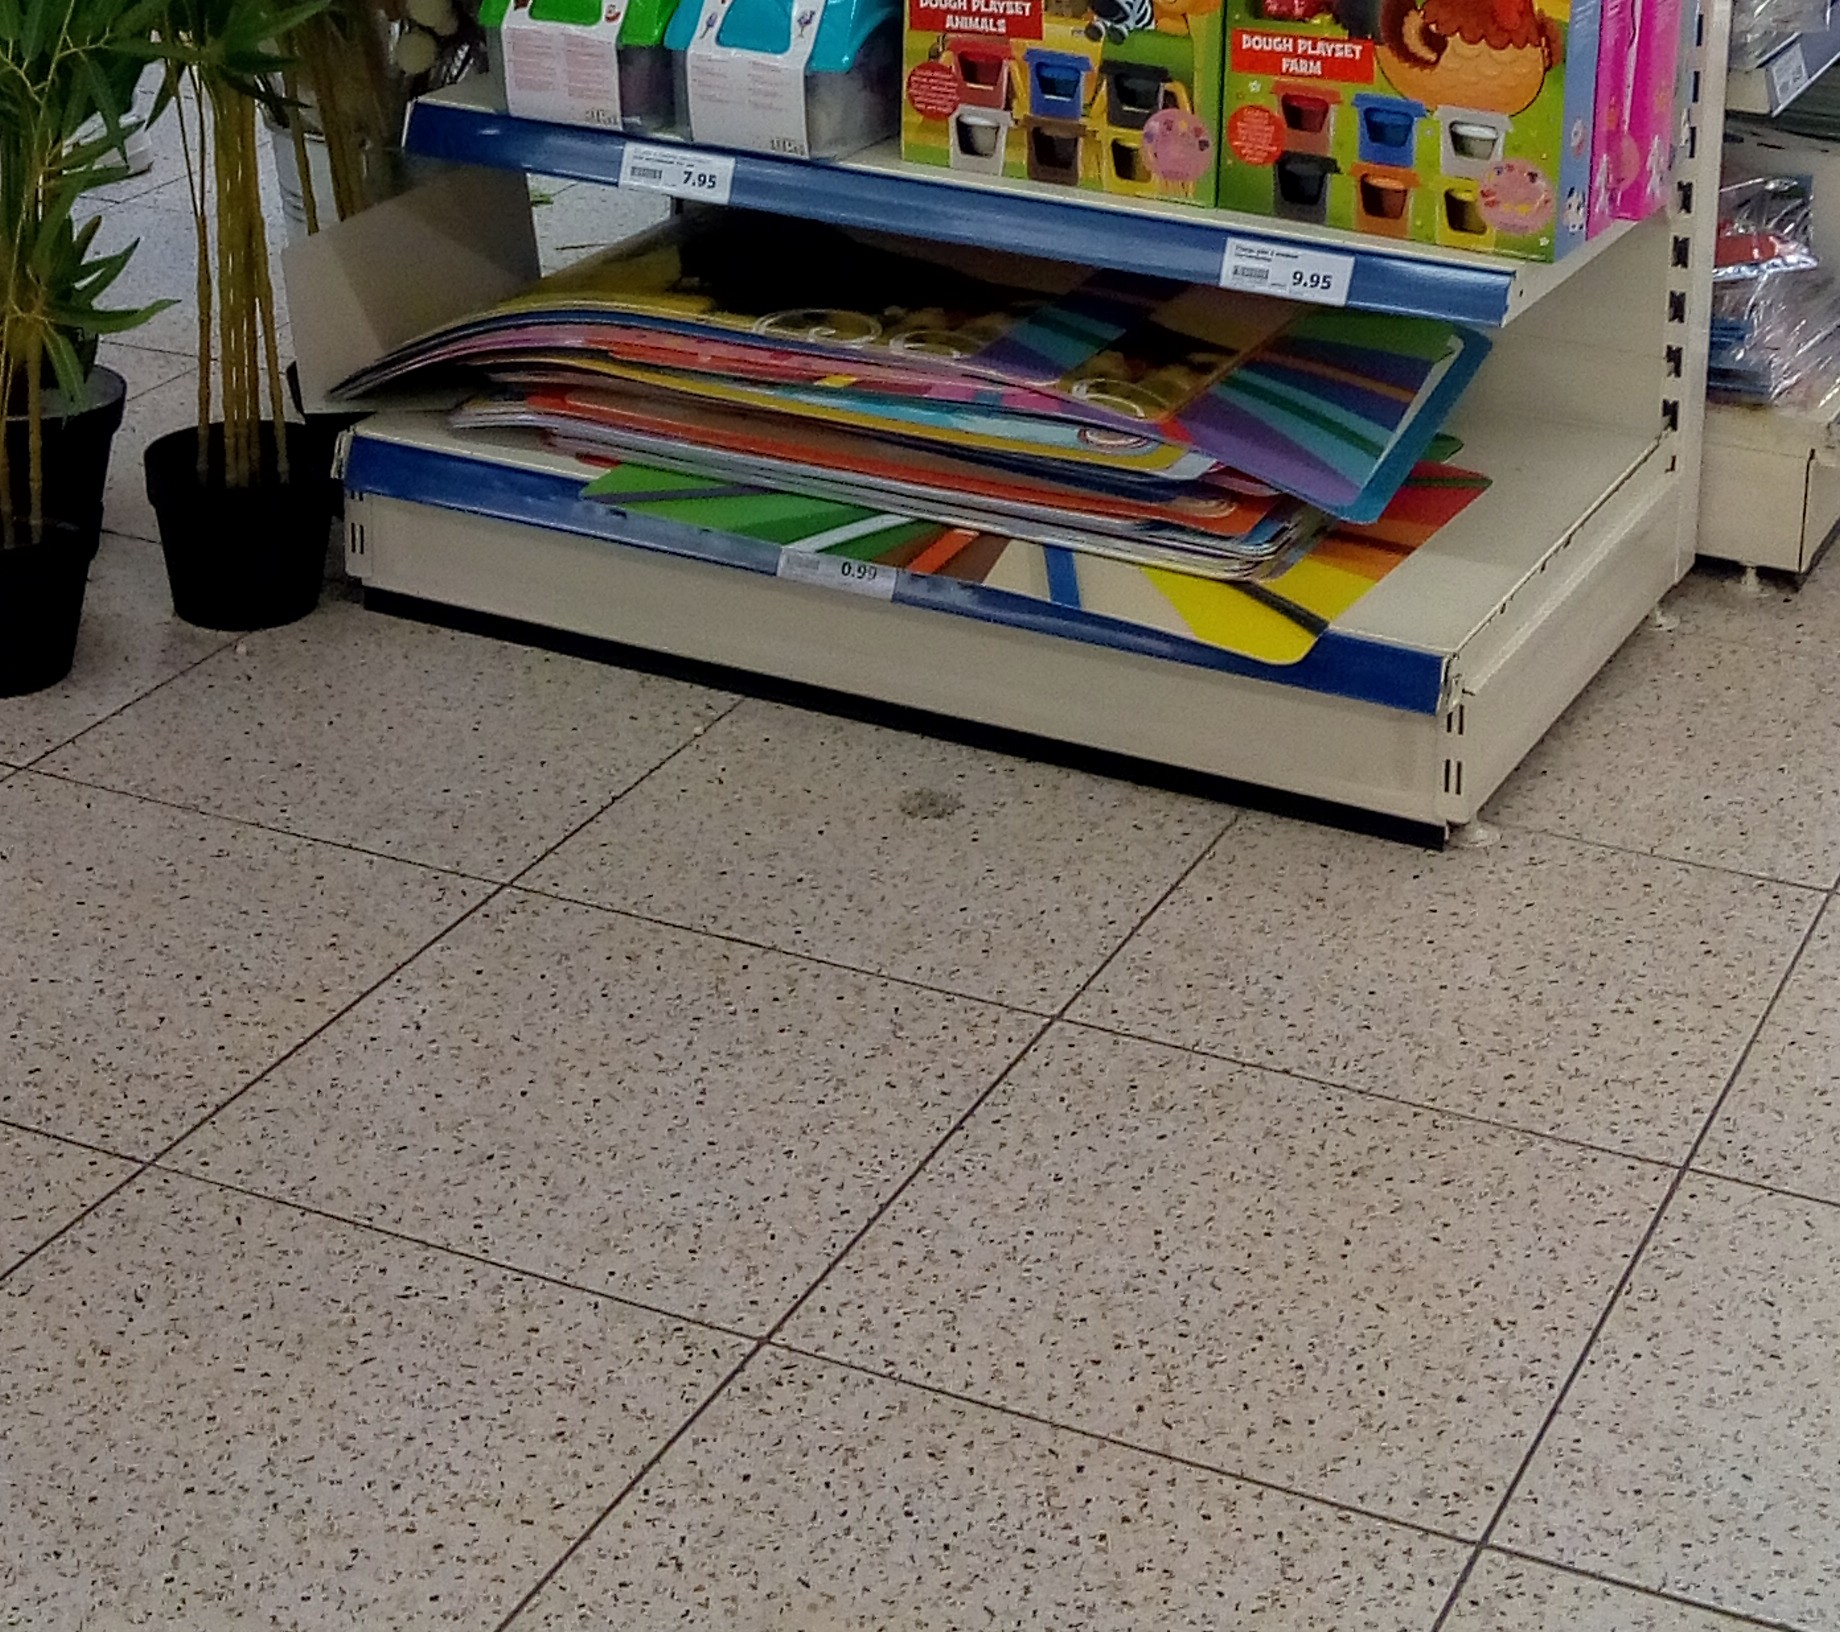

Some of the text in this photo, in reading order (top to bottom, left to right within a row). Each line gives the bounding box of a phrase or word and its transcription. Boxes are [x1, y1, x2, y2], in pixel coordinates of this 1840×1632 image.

[945, 15, 1006, 34] ANIMALS
[1241, 32, 1363, 61] DOUGH PLAYSET
[1281, 56, 1322, 76] FARM
[682, 170, 717, 190] 7.95
[1292, 271, 1332, 291] 9.95
